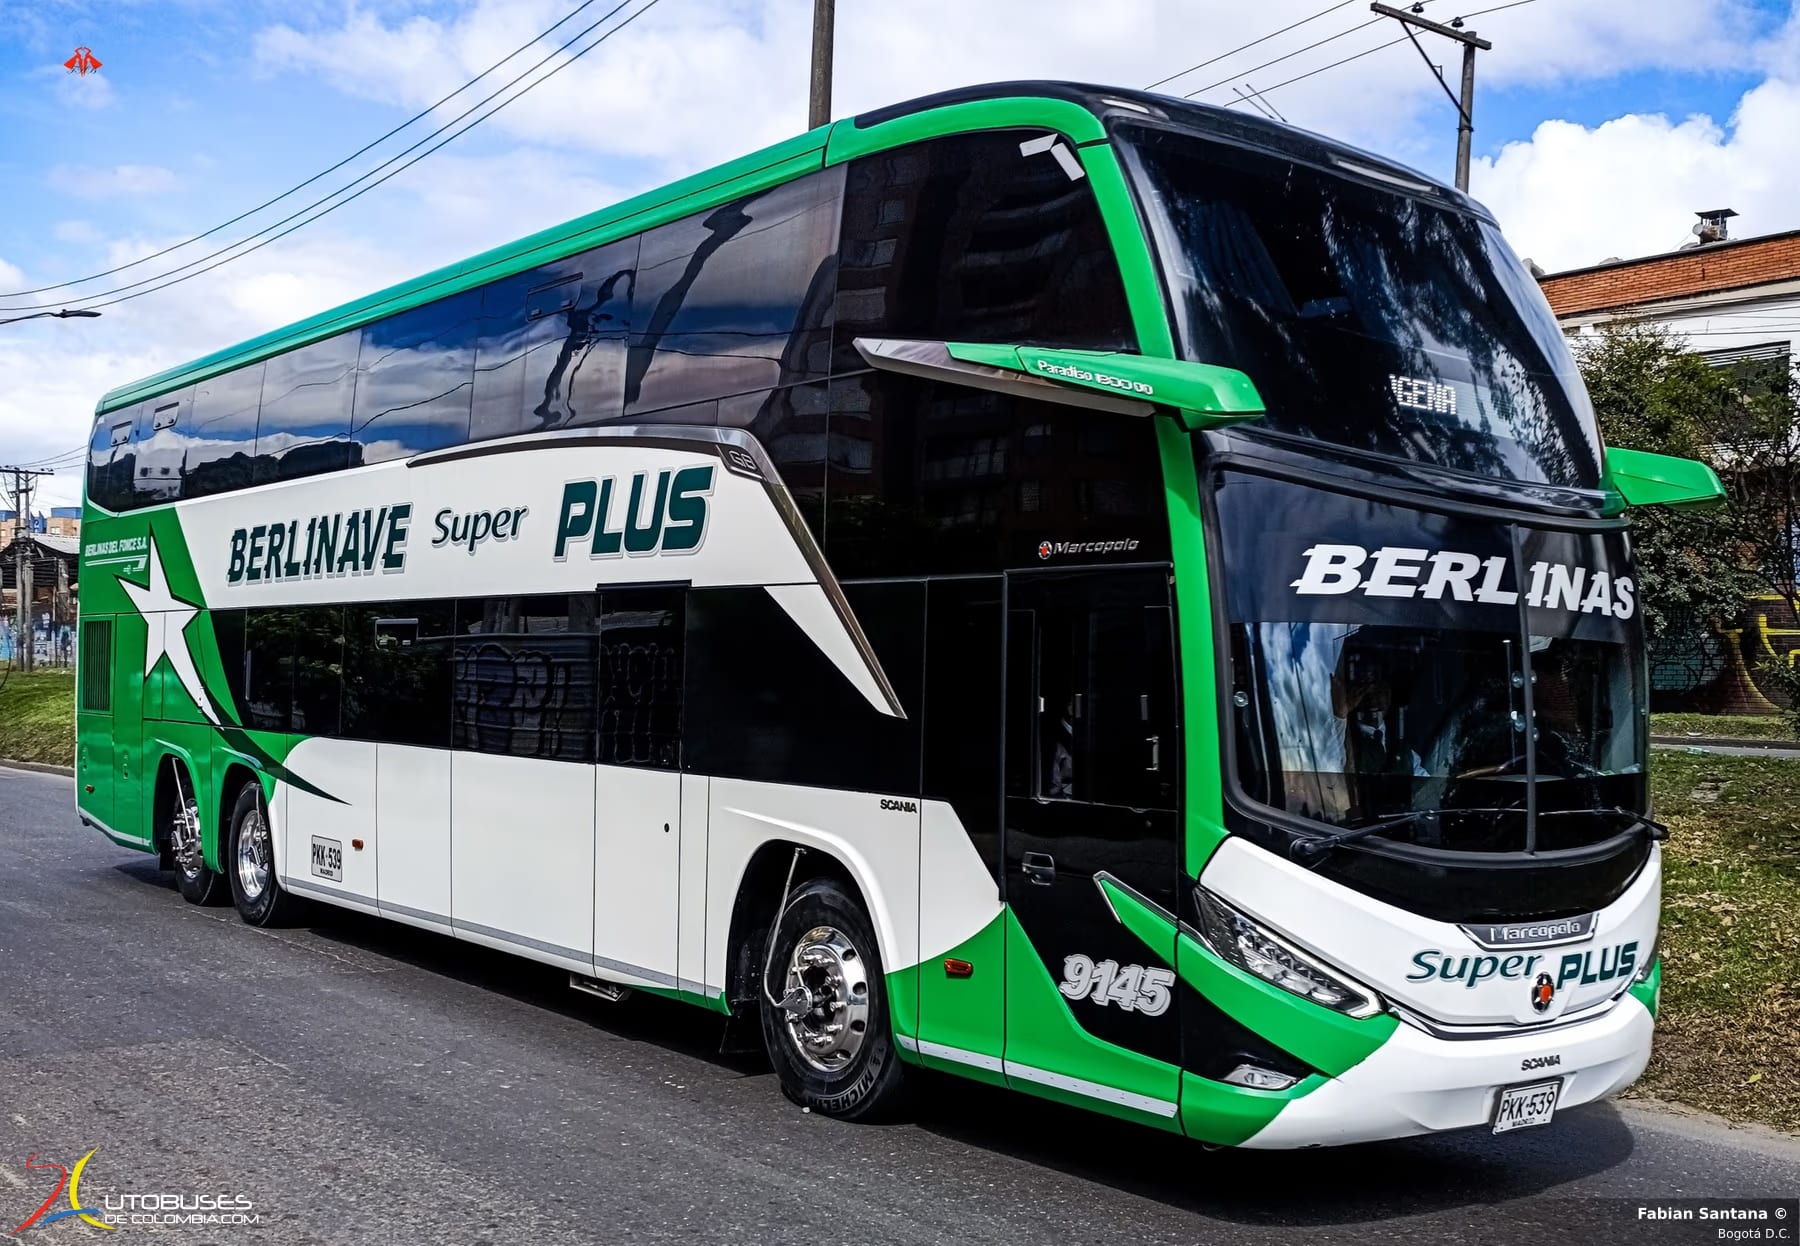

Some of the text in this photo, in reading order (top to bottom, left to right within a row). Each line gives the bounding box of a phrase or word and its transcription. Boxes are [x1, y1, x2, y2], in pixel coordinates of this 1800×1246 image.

[1037, 359, 1093, 381] Paradiso
[227, 463, 718, 587] BERLINAVE Super PLUS
[1053, 538, 1139, 554] Marcopolo
[1289, 544, 1635, 619] BERLINAS
[880, 799, 917, 813] SCANIA
[1490, 920, 1581, 942] Marcopolo
[1406, 941, 1639, 990] Super PLUS
[1059, 953, 1176, 1017] 9145
[1521, 1054, 1561, 1071] SCANIA
